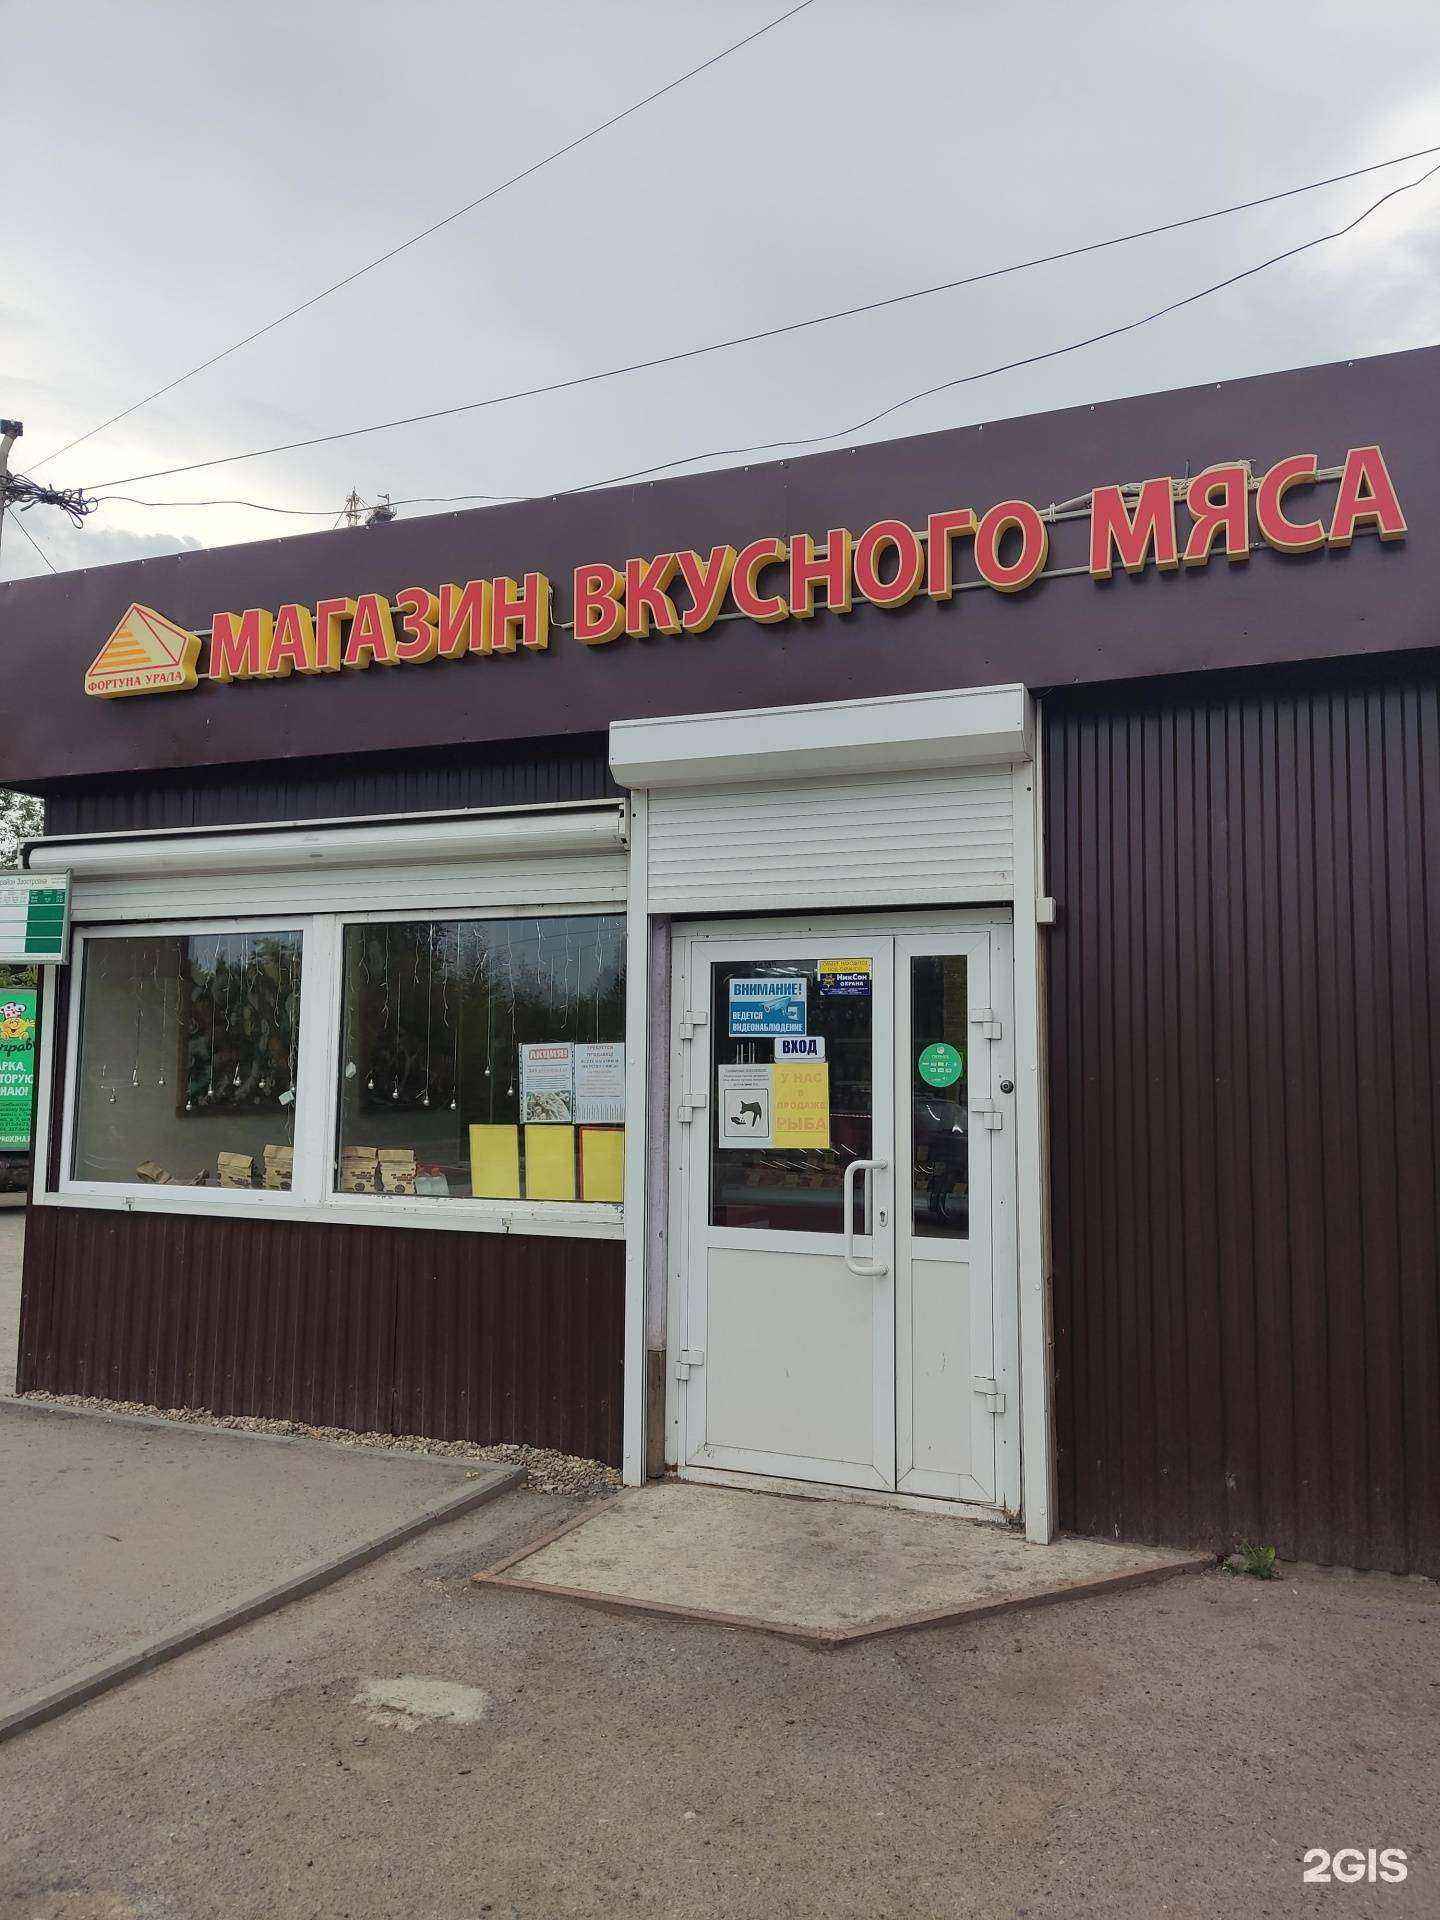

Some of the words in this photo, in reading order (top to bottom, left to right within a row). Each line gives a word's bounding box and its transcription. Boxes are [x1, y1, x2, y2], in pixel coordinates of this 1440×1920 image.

[208, 572, 546, 682] МАГАЗИН
[572, 499, 1049, 645] ВКУСНОГО
[1089, 445, 1408, 579] МЯСА
[88, 676, 141, 692] ФОРТУНА
[146, 671, 182, 684] УРАЛА
[734, 983, 802, 996] ВНИМАНИЕ!
[732, 1011, 763, 1021] ВЕДЕТСЯ
[732, 1022, 804, 1033] ВИДЕОНАБЛЮДЕНИЕ
[782, 1039, 818, 1056] ВХОД
[795, 1073, 822, 1083] НАС
[776, 1116, 826, 1131] РЫБА
